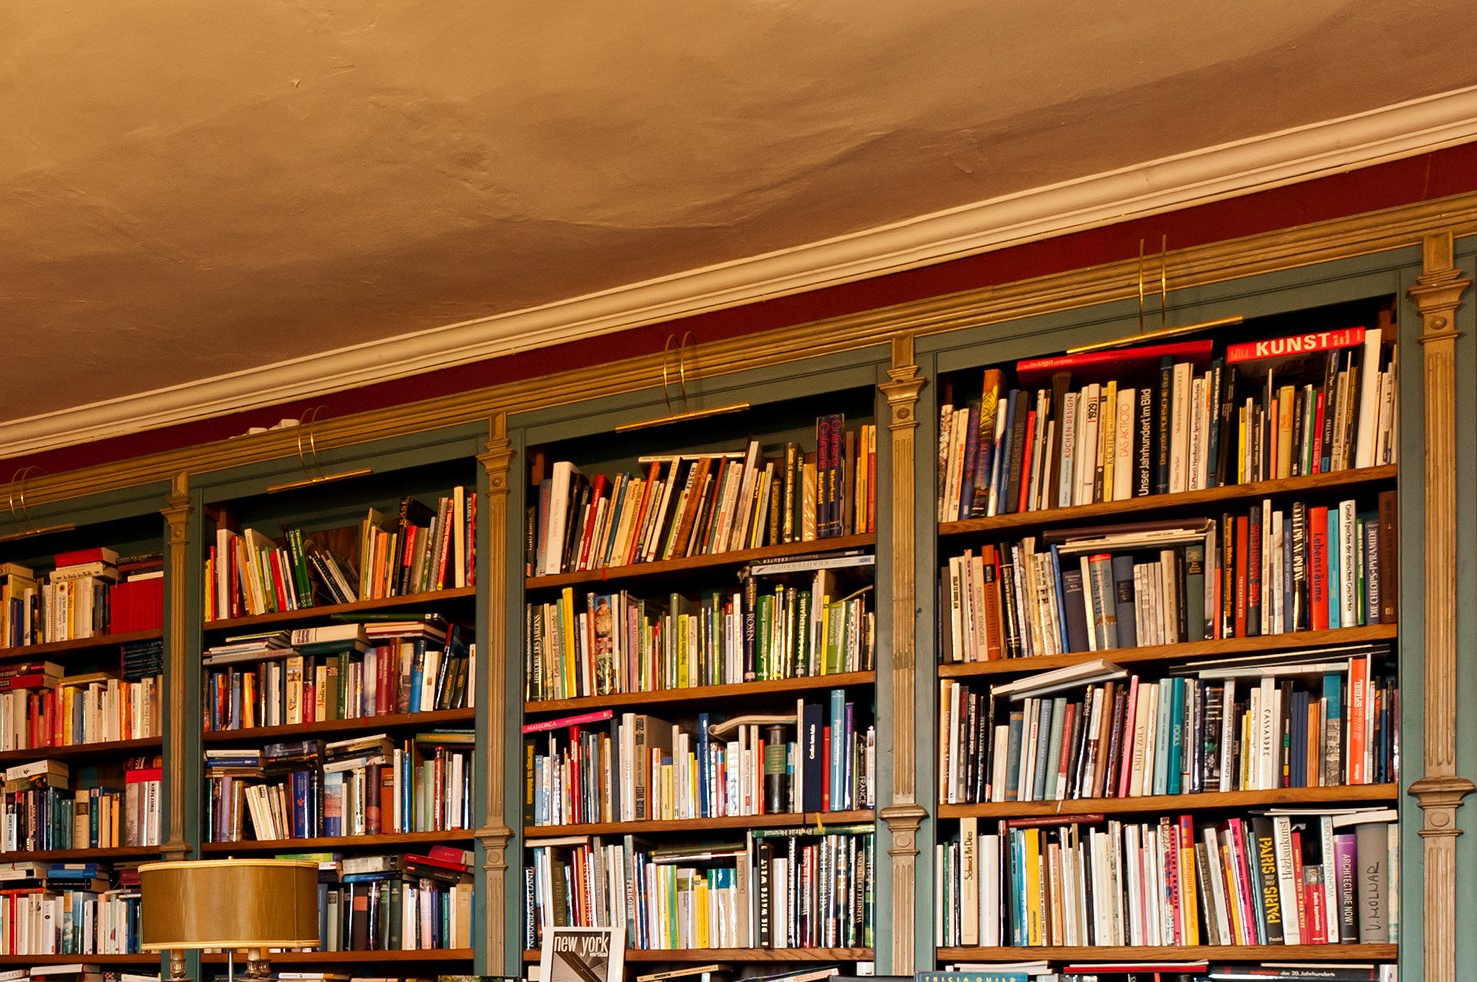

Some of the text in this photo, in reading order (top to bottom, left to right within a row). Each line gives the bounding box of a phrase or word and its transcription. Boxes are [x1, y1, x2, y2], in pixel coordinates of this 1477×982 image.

[1256, 333, 1331, 357] KUNST
[1063, 396, 1074, 458] KÜCHEN-DESIGN
[1118, 403, 1130, 458] DAS AKTFOTO
[1138, 388, 1151, 496] Unser Jahrhundert im Bild
[1011, 422, 1023, 481] DESIGNKULTUR
[685, 467, 697, 489] FISCH
[1346, 504, 1354, 520] Große
[1345, 522, 1353, 543] Epochen
[1314, 533, 1325, 603] Lebensräume
[1367, 528, 1378, 617] DIE CHEOPS-PYRAMIDE
[1345, 583, 1353, 611] Geschichte
[533, 614, 541, 641] JARDINS
[746, 613, 755, 641] ROSEN
[799, 598, 807, 647] GARTENJAHR
[533, 655, 541, 683] HISTOIRE
[1083, 692, 1091, 717] PAPIER
[1353, 679, 1363, 707] SPIEGEL
[526, 720, 557, 731] MALLORCA
[1135, 725, 1144, 747] ZOLA
[1173, 724, 1181, 746] POOLS
[1263, 709, 1271, 756] CASSANDRE
[635, 786, 645, 818] UNSERE WELT
[859, 776, 867, 805] FRANCE
[764, 828, 788, 837] Heimat
[964, 830, 974, 881] Schmuck Art Déco
[1259, 837, 1275, 874] PARIS
[1279, 820, 1294, 881] Holzbaukunst
[1323, 820, 1335, 898] WOHNEN PARADIES
[760, 858, 768, 932] DIE WEITE WELT
[1264, 887, 1281, 923] PARIS
[1343, 854, 1355, 926] ARCHITECTURE NOW!
[554, 931, 609, 957] new york
